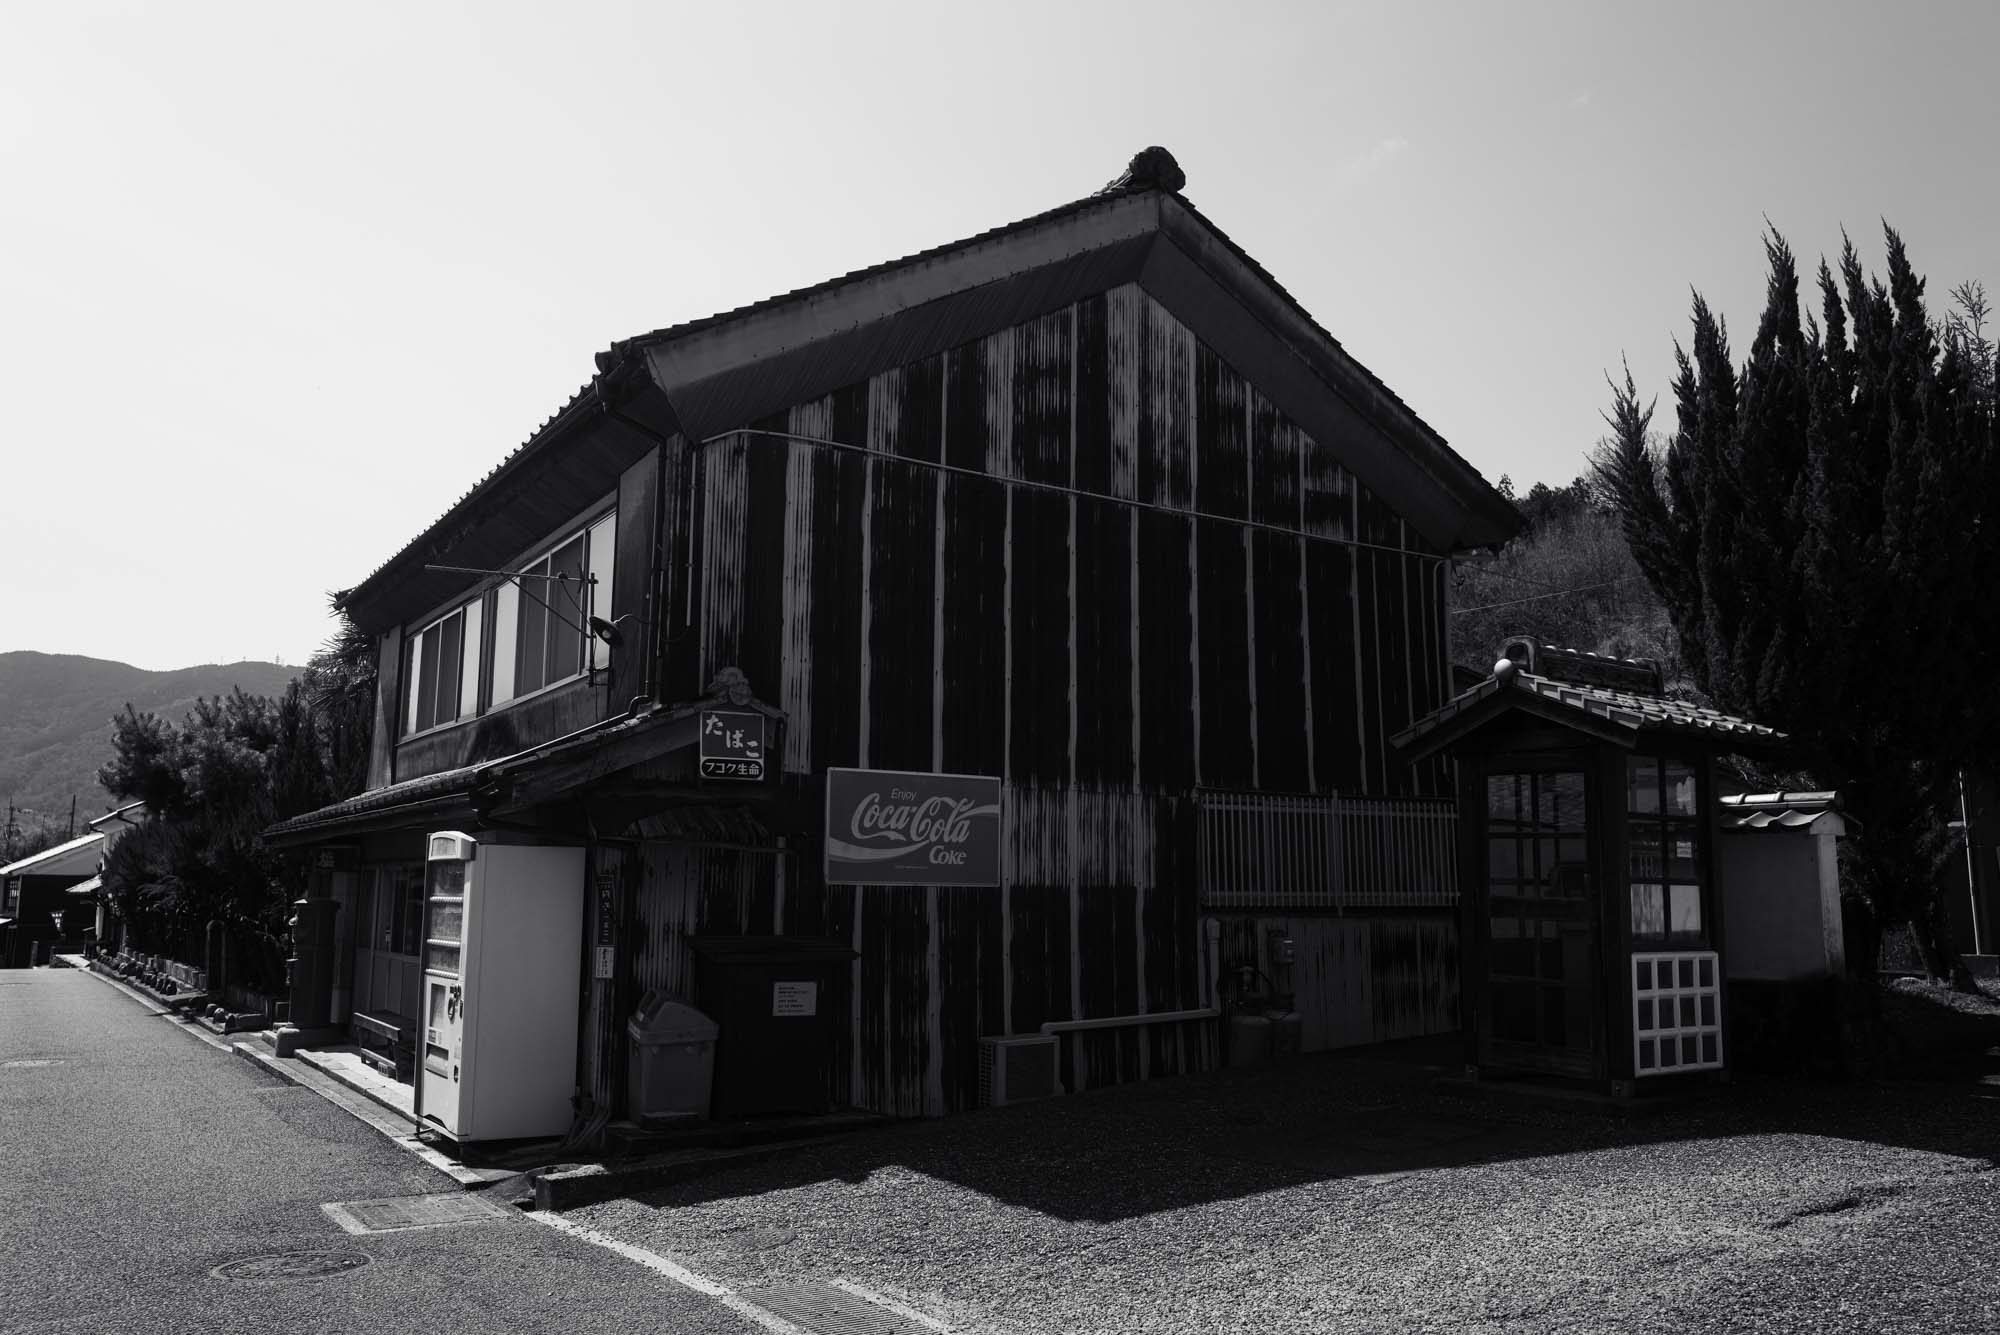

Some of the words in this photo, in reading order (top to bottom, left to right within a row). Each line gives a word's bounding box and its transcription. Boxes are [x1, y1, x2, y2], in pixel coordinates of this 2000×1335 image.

[705, 714, 760, 758] たばこ
[705, 762, 760, 775] フコク生命
[890, 787, 917, 801] Enjoy
[851, 792, 976, 843] Coca-Cola
[928, 845, 967, 865] Coke
